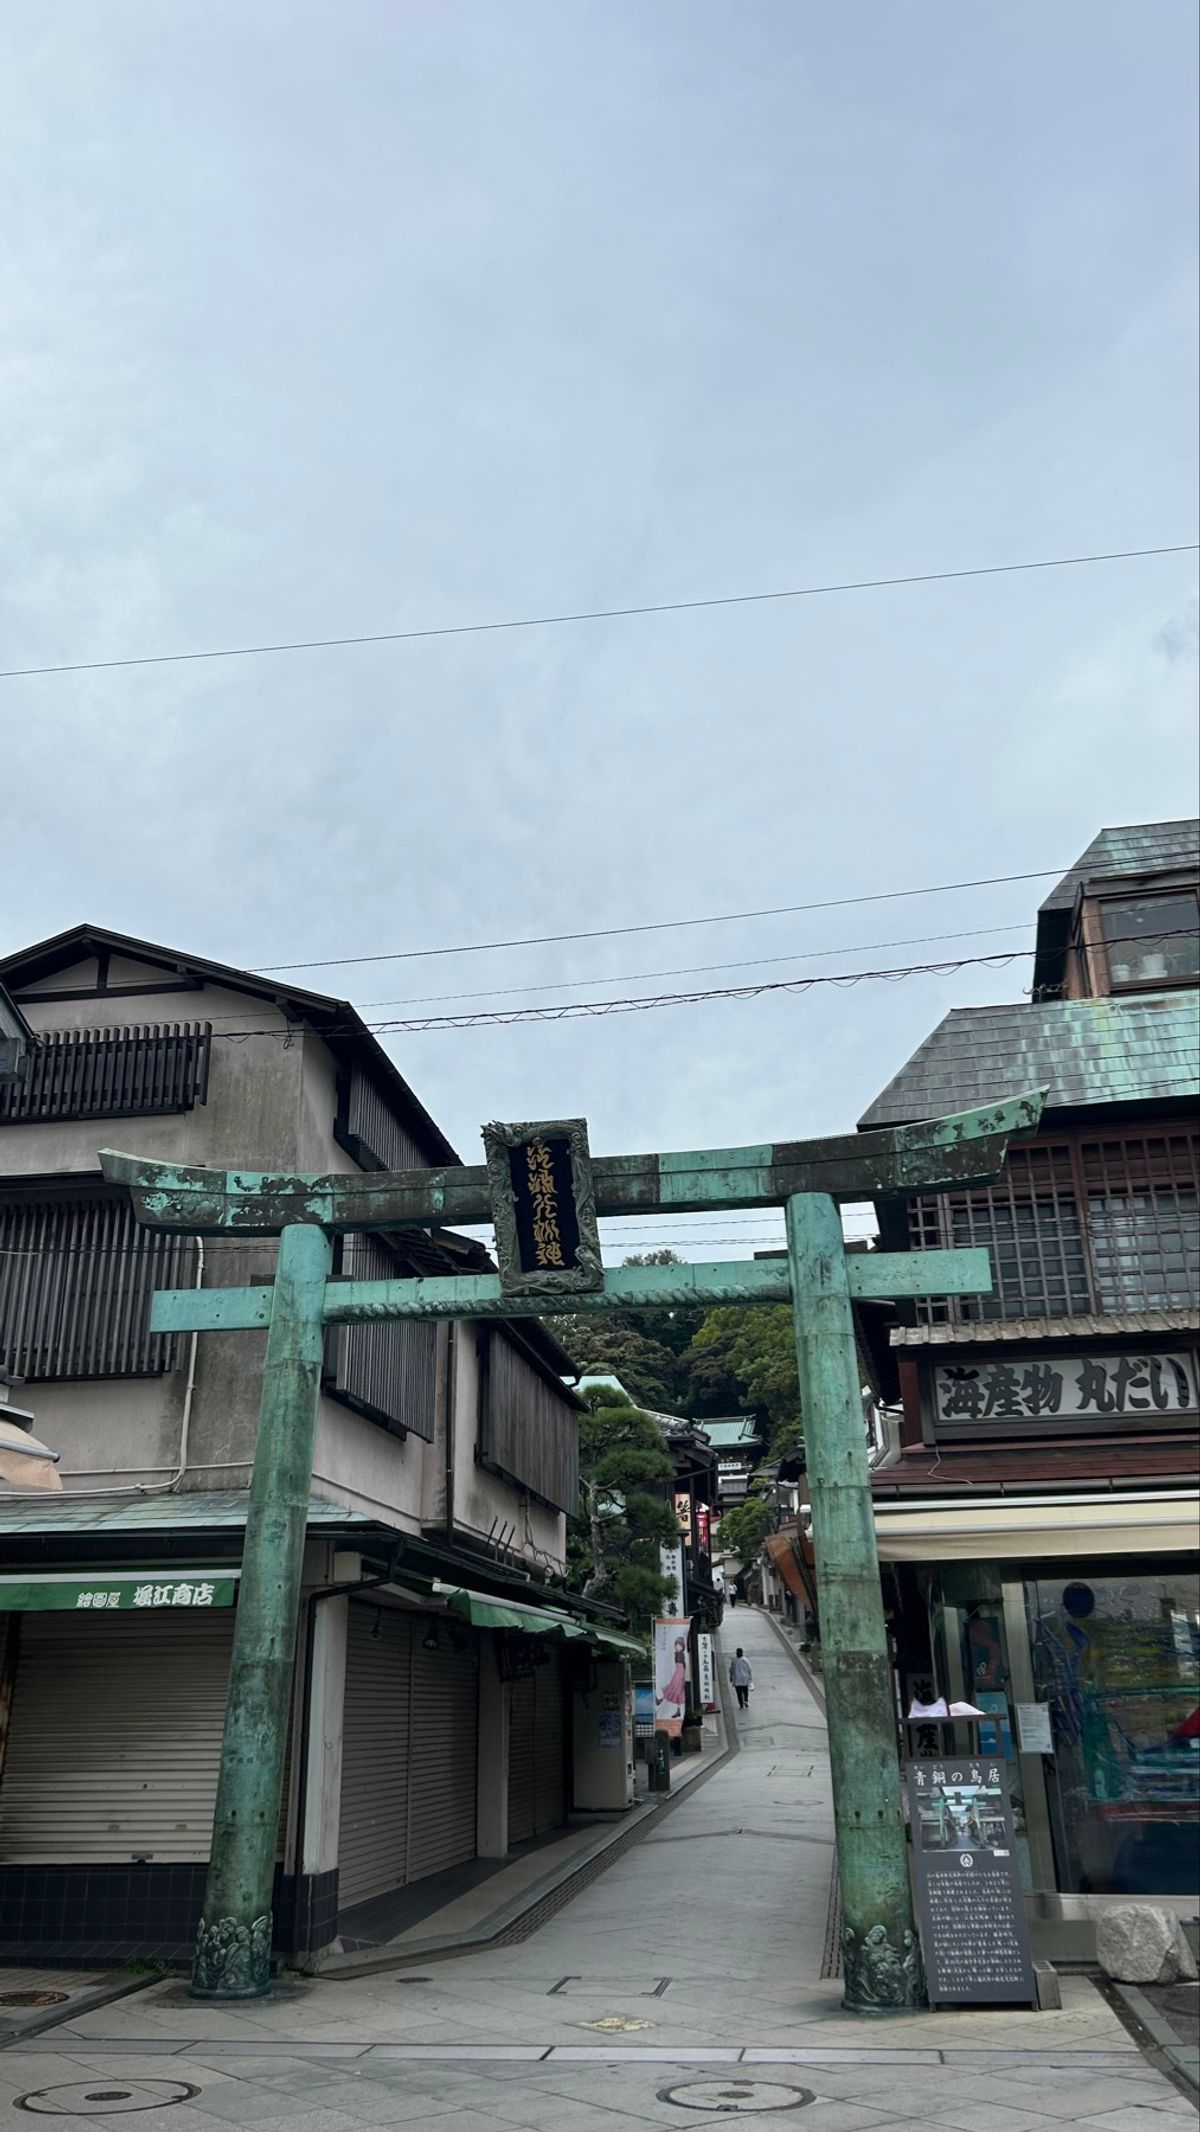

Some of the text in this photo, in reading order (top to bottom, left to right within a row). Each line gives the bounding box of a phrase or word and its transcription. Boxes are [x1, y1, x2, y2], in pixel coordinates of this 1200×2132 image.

[939, 1357, 1190, 1418] 海産物 丸だい
[133, 1583, 215, 1606] 堀江商店
[913, 1679, 938, 1757] 海産
[914, 1768, 1000, 1786] 青銅の鳥居
